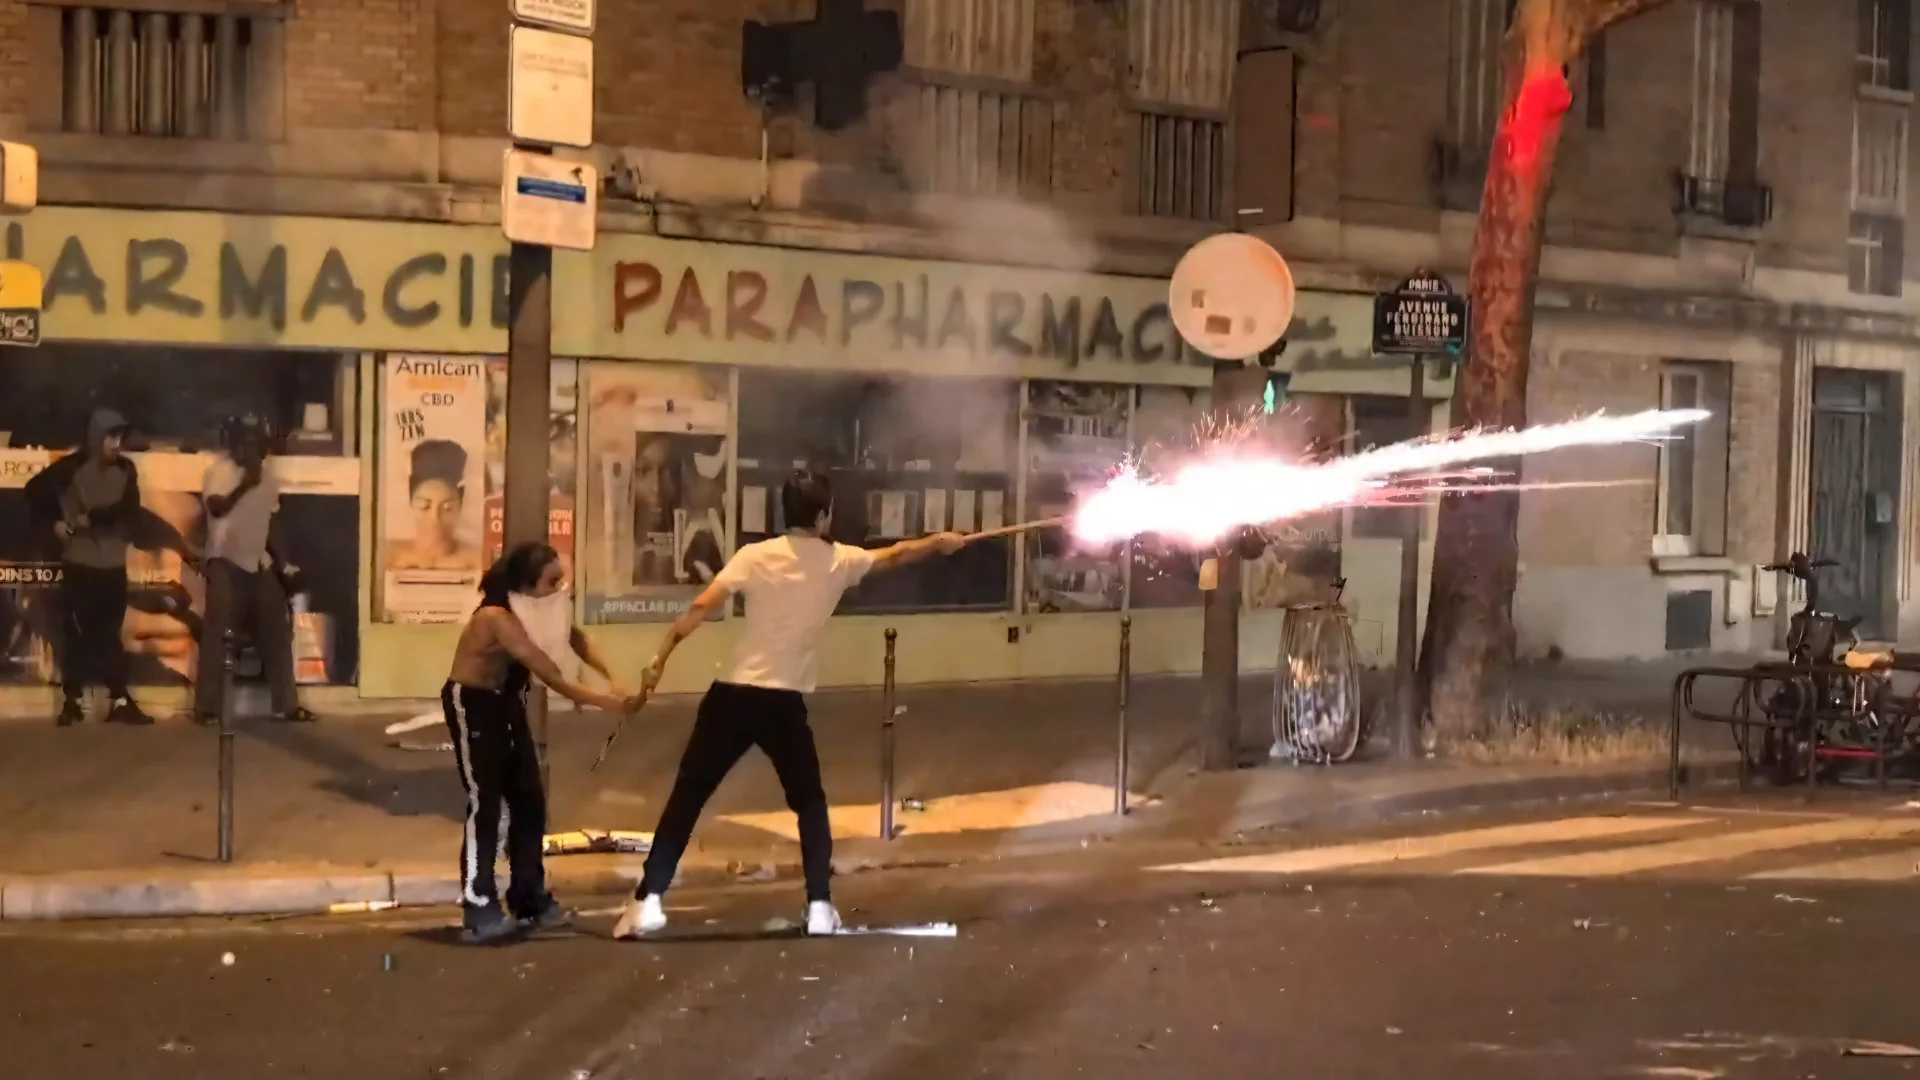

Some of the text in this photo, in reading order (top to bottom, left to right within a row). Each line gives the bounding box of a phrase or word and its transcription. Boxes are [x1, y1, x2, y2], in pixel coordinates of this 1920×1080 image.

[7, 221, 510, 332] ARMACI
[614, 260, 1213, 367] PARAPHARMACI
[1399, 300, 1448, 314] AVENUE
[420, 392, 454, 406] CBD
